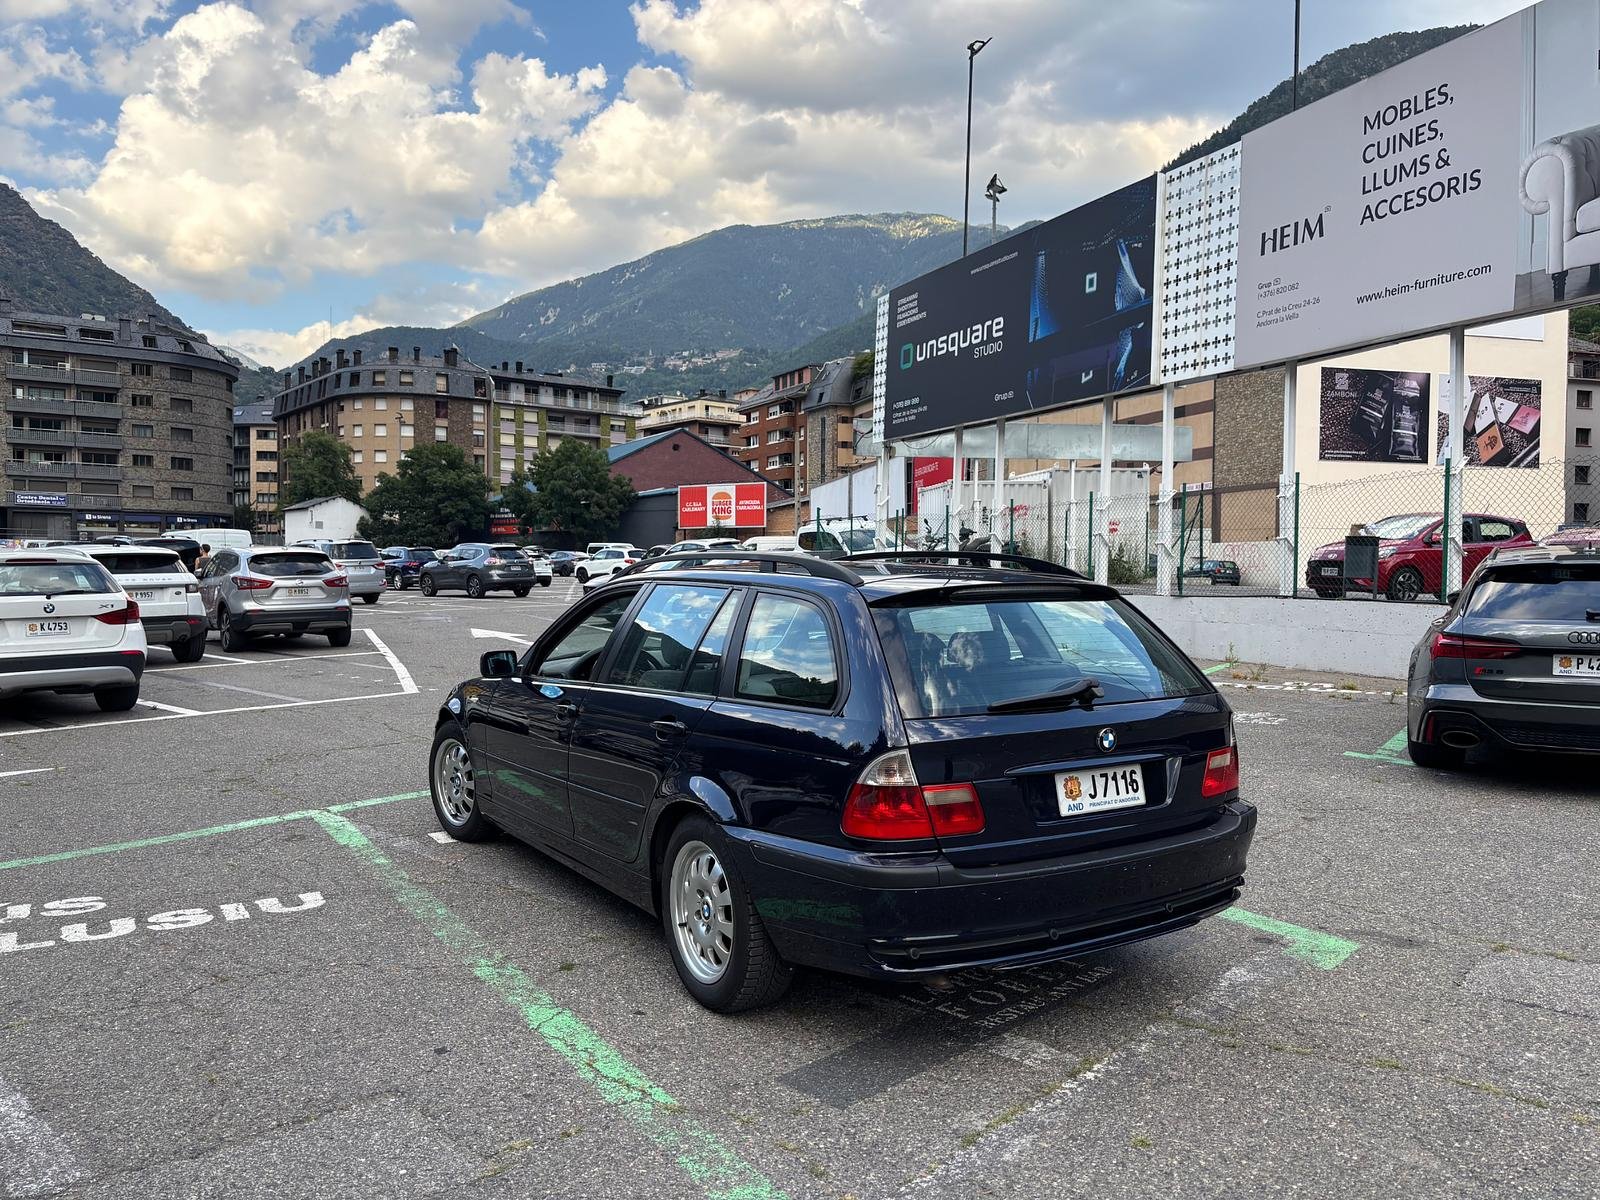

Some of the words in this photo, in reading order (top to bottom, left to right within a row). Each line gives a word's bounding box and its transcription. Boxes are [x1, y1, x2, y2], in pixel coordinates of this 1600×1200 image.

[1363, 83, 1454, 135] MOBLES,
[1362, 119, 1444, 164] CUINES,
[1362, 154, 1430, 195] LLUMS
[1435, 148, 1451, 169] &
[1360, 169, 1482, 225] ACCESORIS
[1260, 213, 1324, 256] HEIM
[1257, 281, 1272, 290] Grup
[1356, 264, 1492, 304] www.heim-furniture.com
[1287, 302, 1302, 311] Creu
[1256, 315, 1278, 328] Andorra
[916, 316, 1004, 361] unsquare
[974, 341, 1003, 358] STUDIO
[994, 392, 1008, 401] Grup
[712, 506, 732, 515] KING
[1067, 802, 1084, 812] AND
